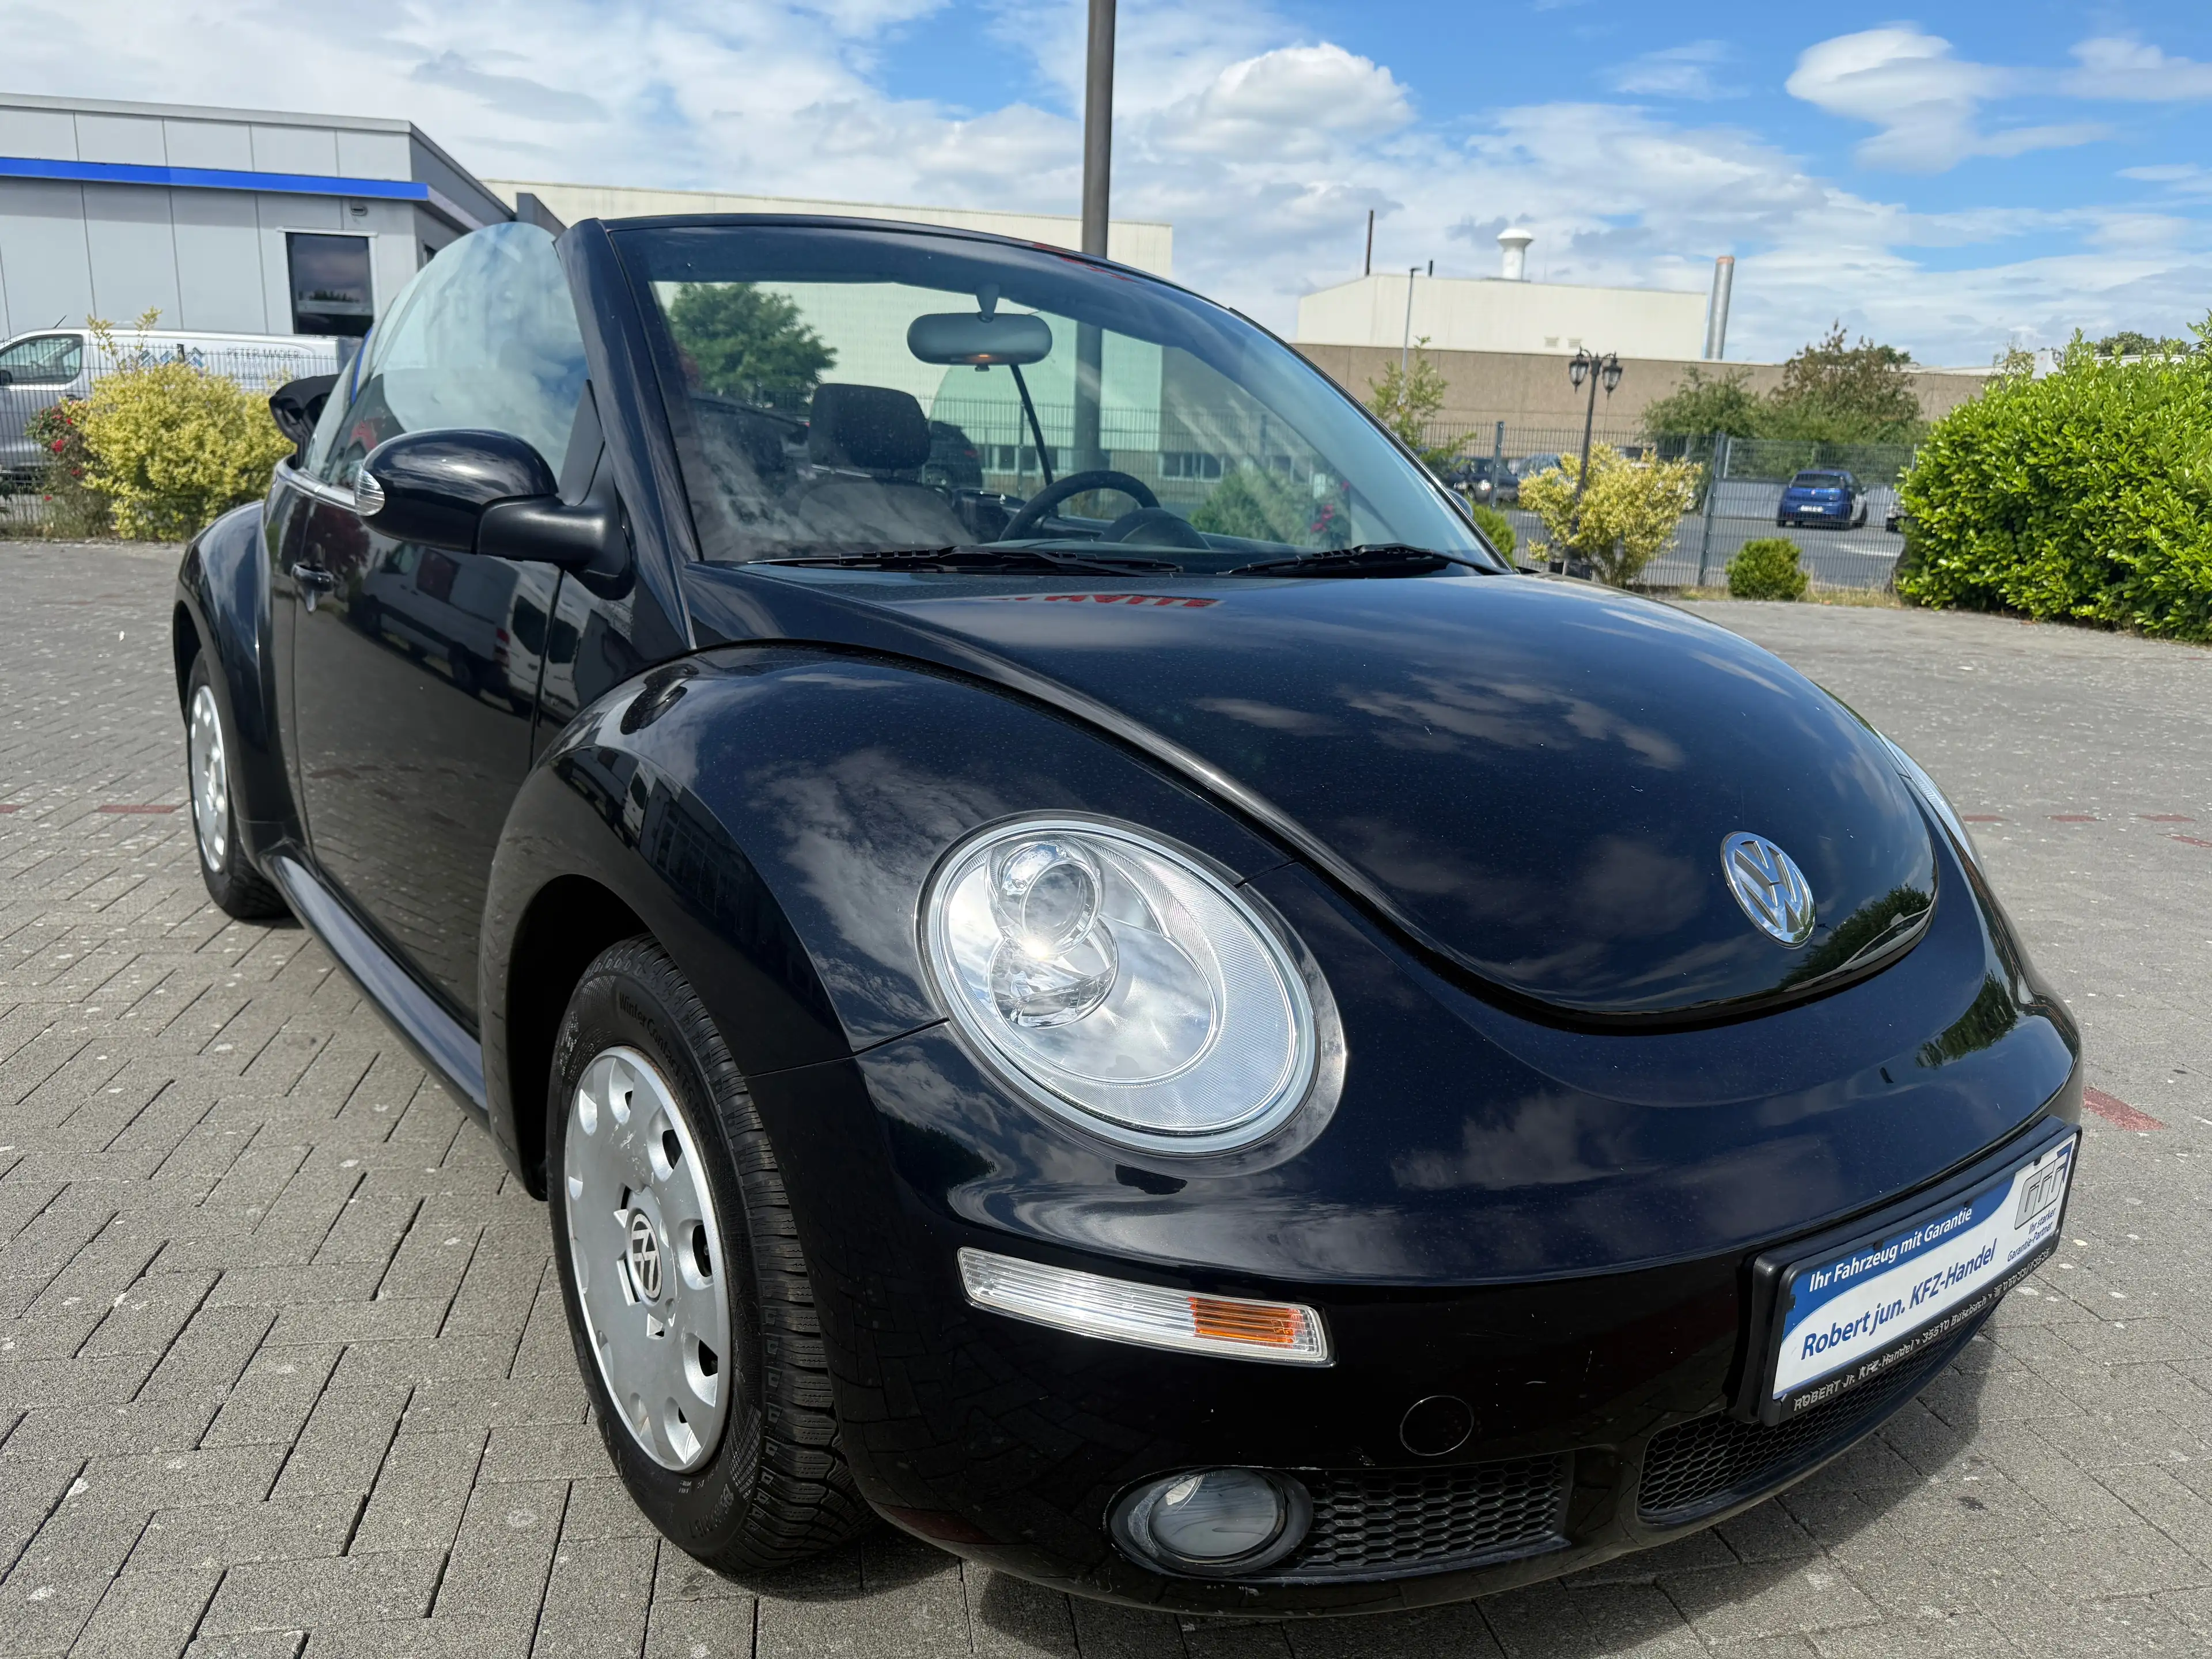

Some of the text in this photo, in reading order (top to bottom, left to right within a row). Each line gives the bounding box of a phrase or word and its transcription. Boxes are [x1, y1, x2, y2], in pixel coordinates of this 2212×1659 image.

[1809, 1207, 1972, 1292] Ihr Fahrzeug mit Garantie
[2008, 1221, 2053, 1262] Garantie-Partner
[2028, 1207, 2056, 1235] Ihr starker
[1801, 1238, 1997, 1361] Robert jun. KFZ-Handel
[1794, 1380, 1841, 1411] ROBERT
[1858, 1339, 1915, 1380] KFZ-Handel
[1922, 1319, 1950, 1344] 35510
